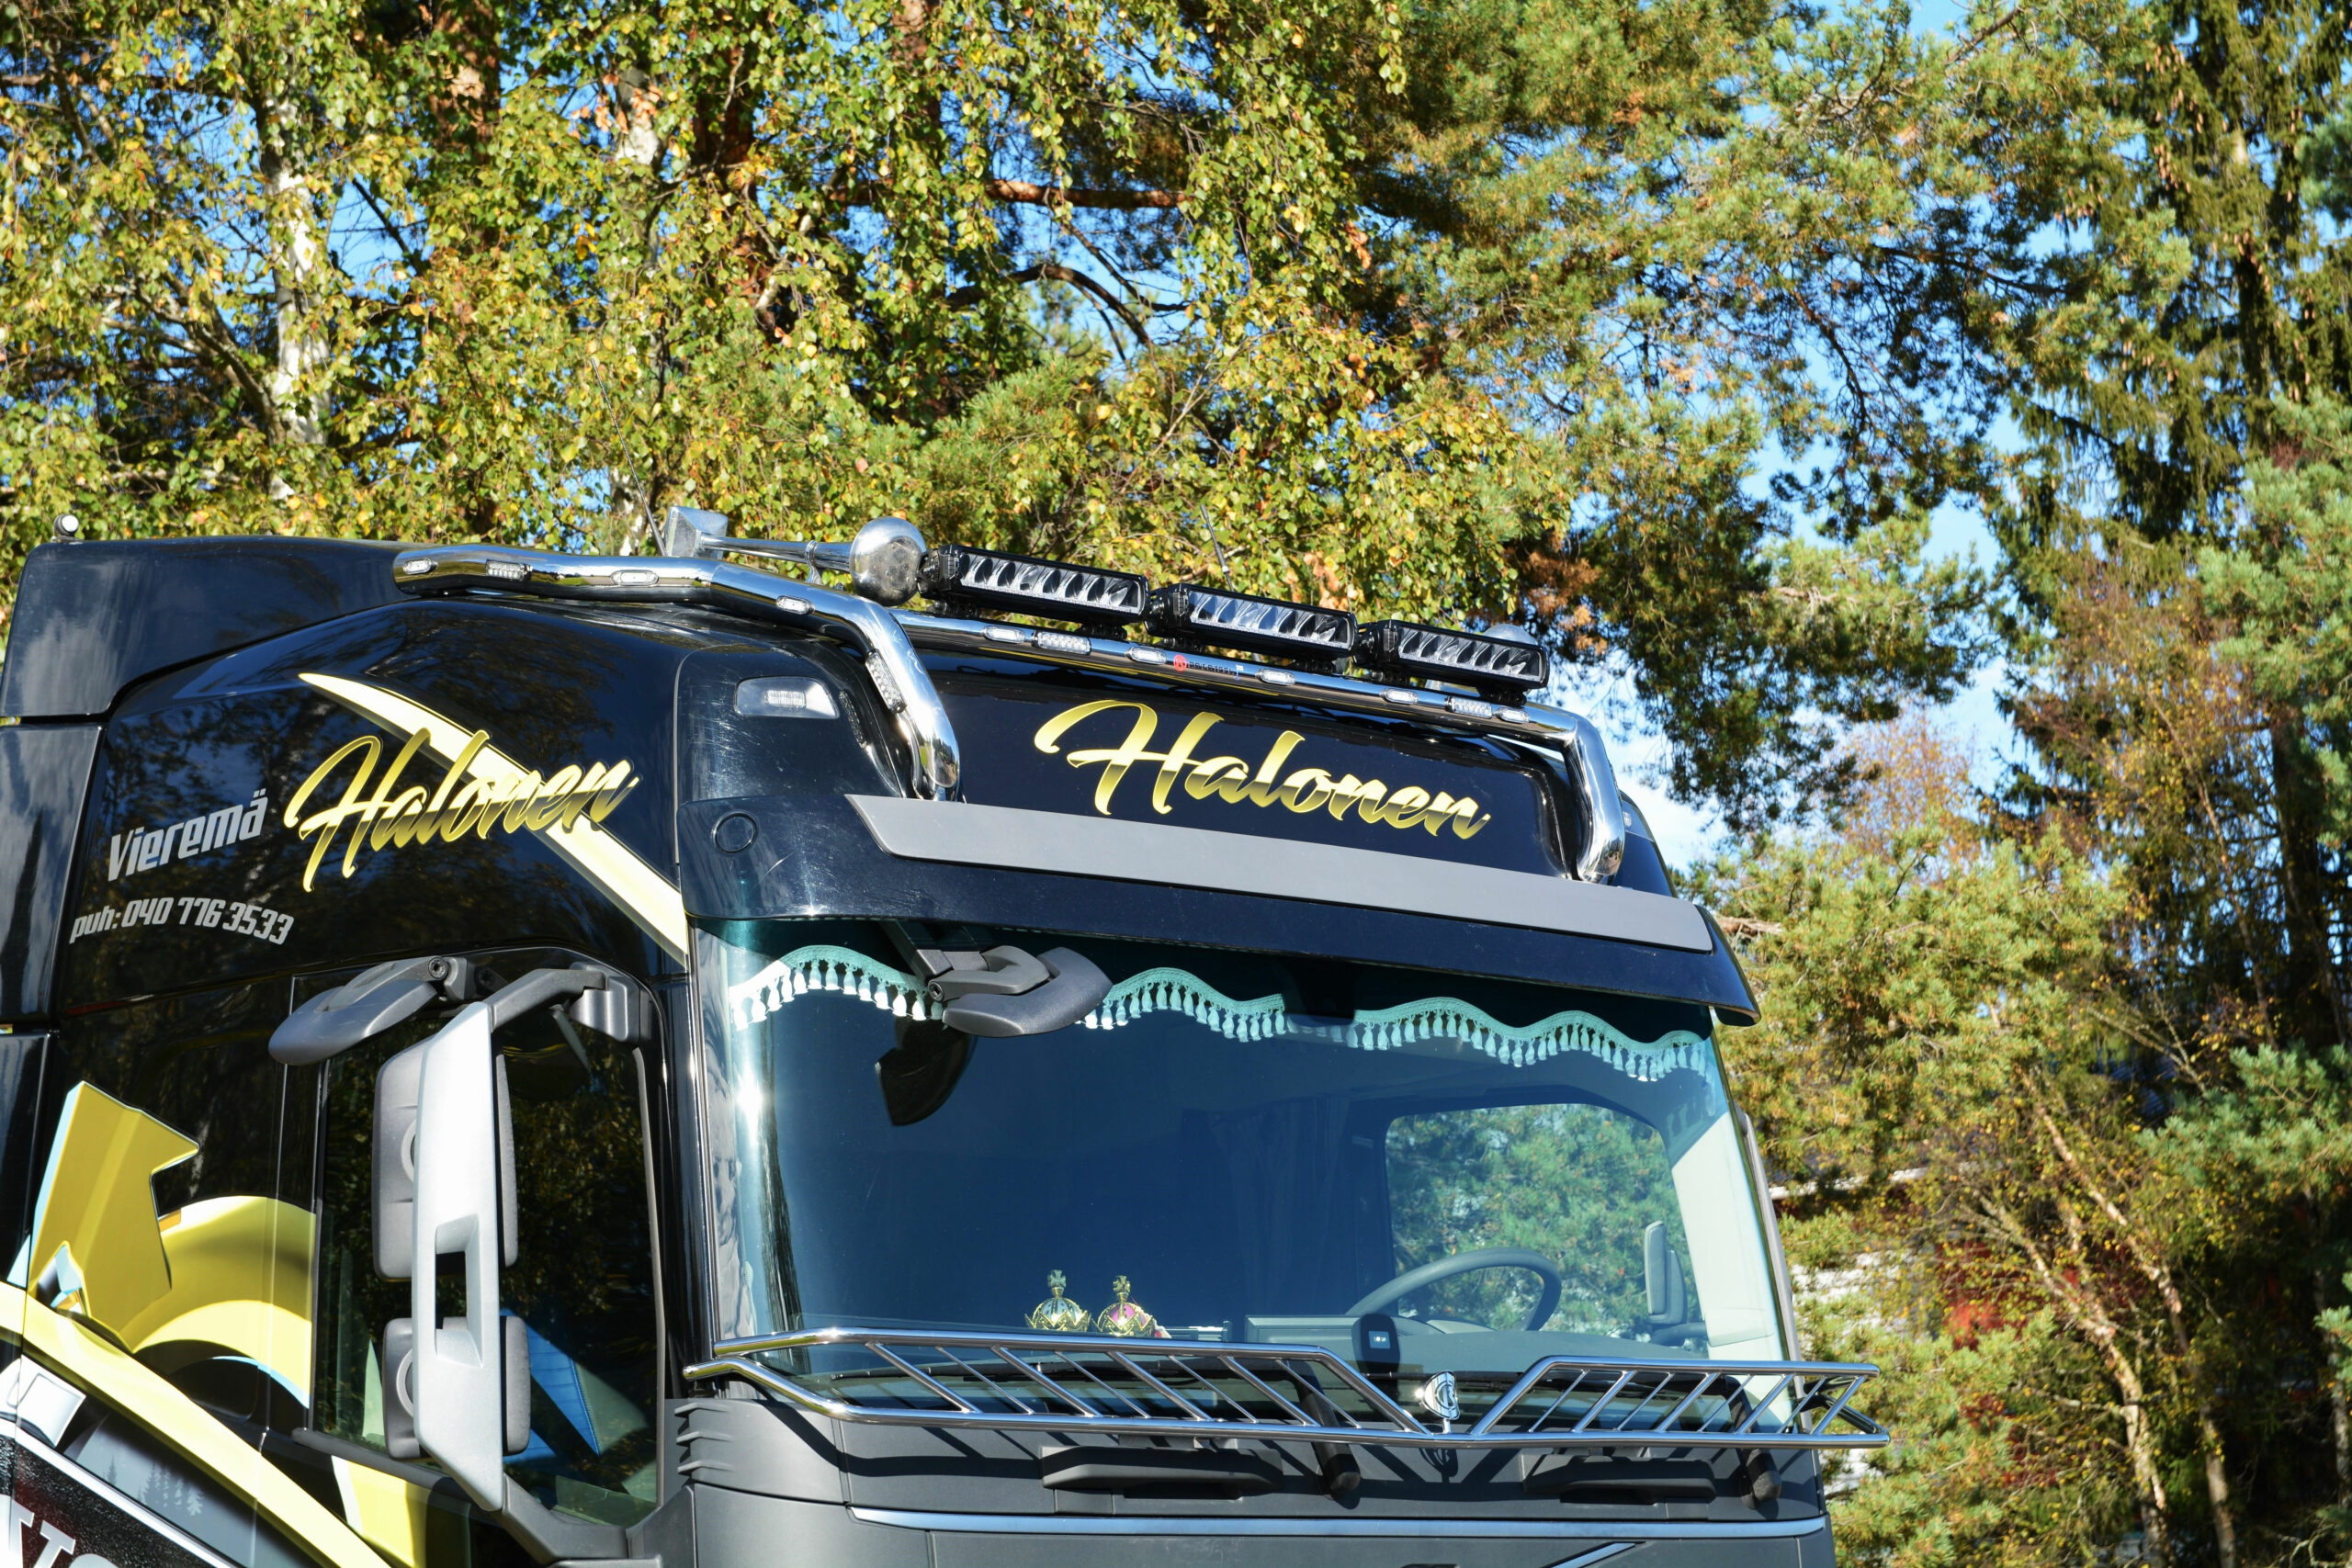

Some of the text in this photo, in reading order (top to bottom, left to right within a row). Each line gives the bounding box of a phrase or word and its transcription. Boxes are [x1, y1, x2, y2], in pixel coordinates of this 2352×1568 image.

[284, 727, 640, 893] Halonen
[1035, 700, 1491, 840] Halonen
[107, 788, 268, 882] Vieremä
[69, 897, 295, 945] puh: 040 776 3533
